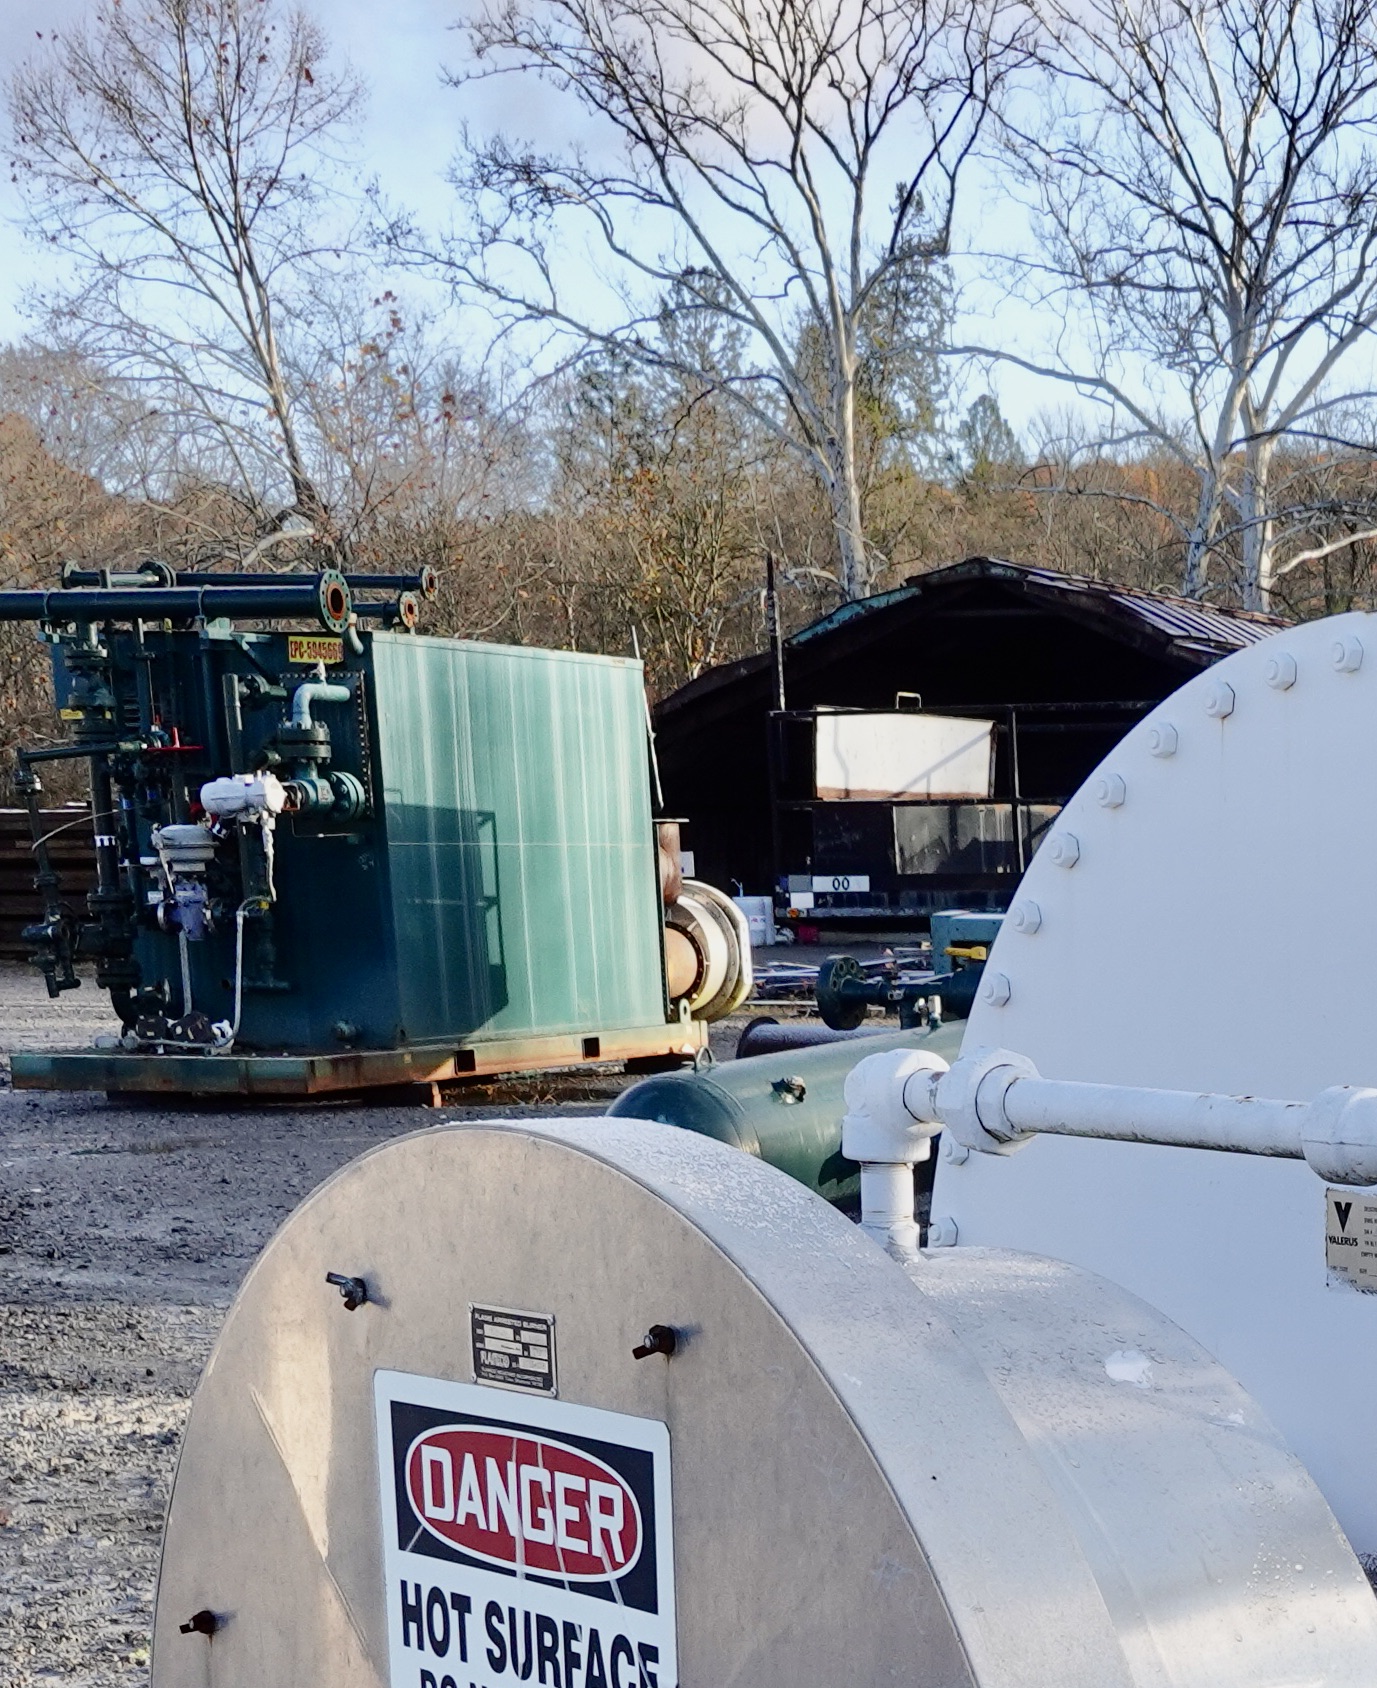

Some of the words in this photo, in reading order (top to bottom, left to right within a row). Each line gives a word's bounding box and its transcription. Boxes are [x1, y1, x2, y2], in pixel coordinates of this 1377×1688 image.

[1328, 1236, 1358, 1247] VALERUS
[420, 1443, 625, 1564] DANGER
[400, 1579, 472, 1663] HOT
